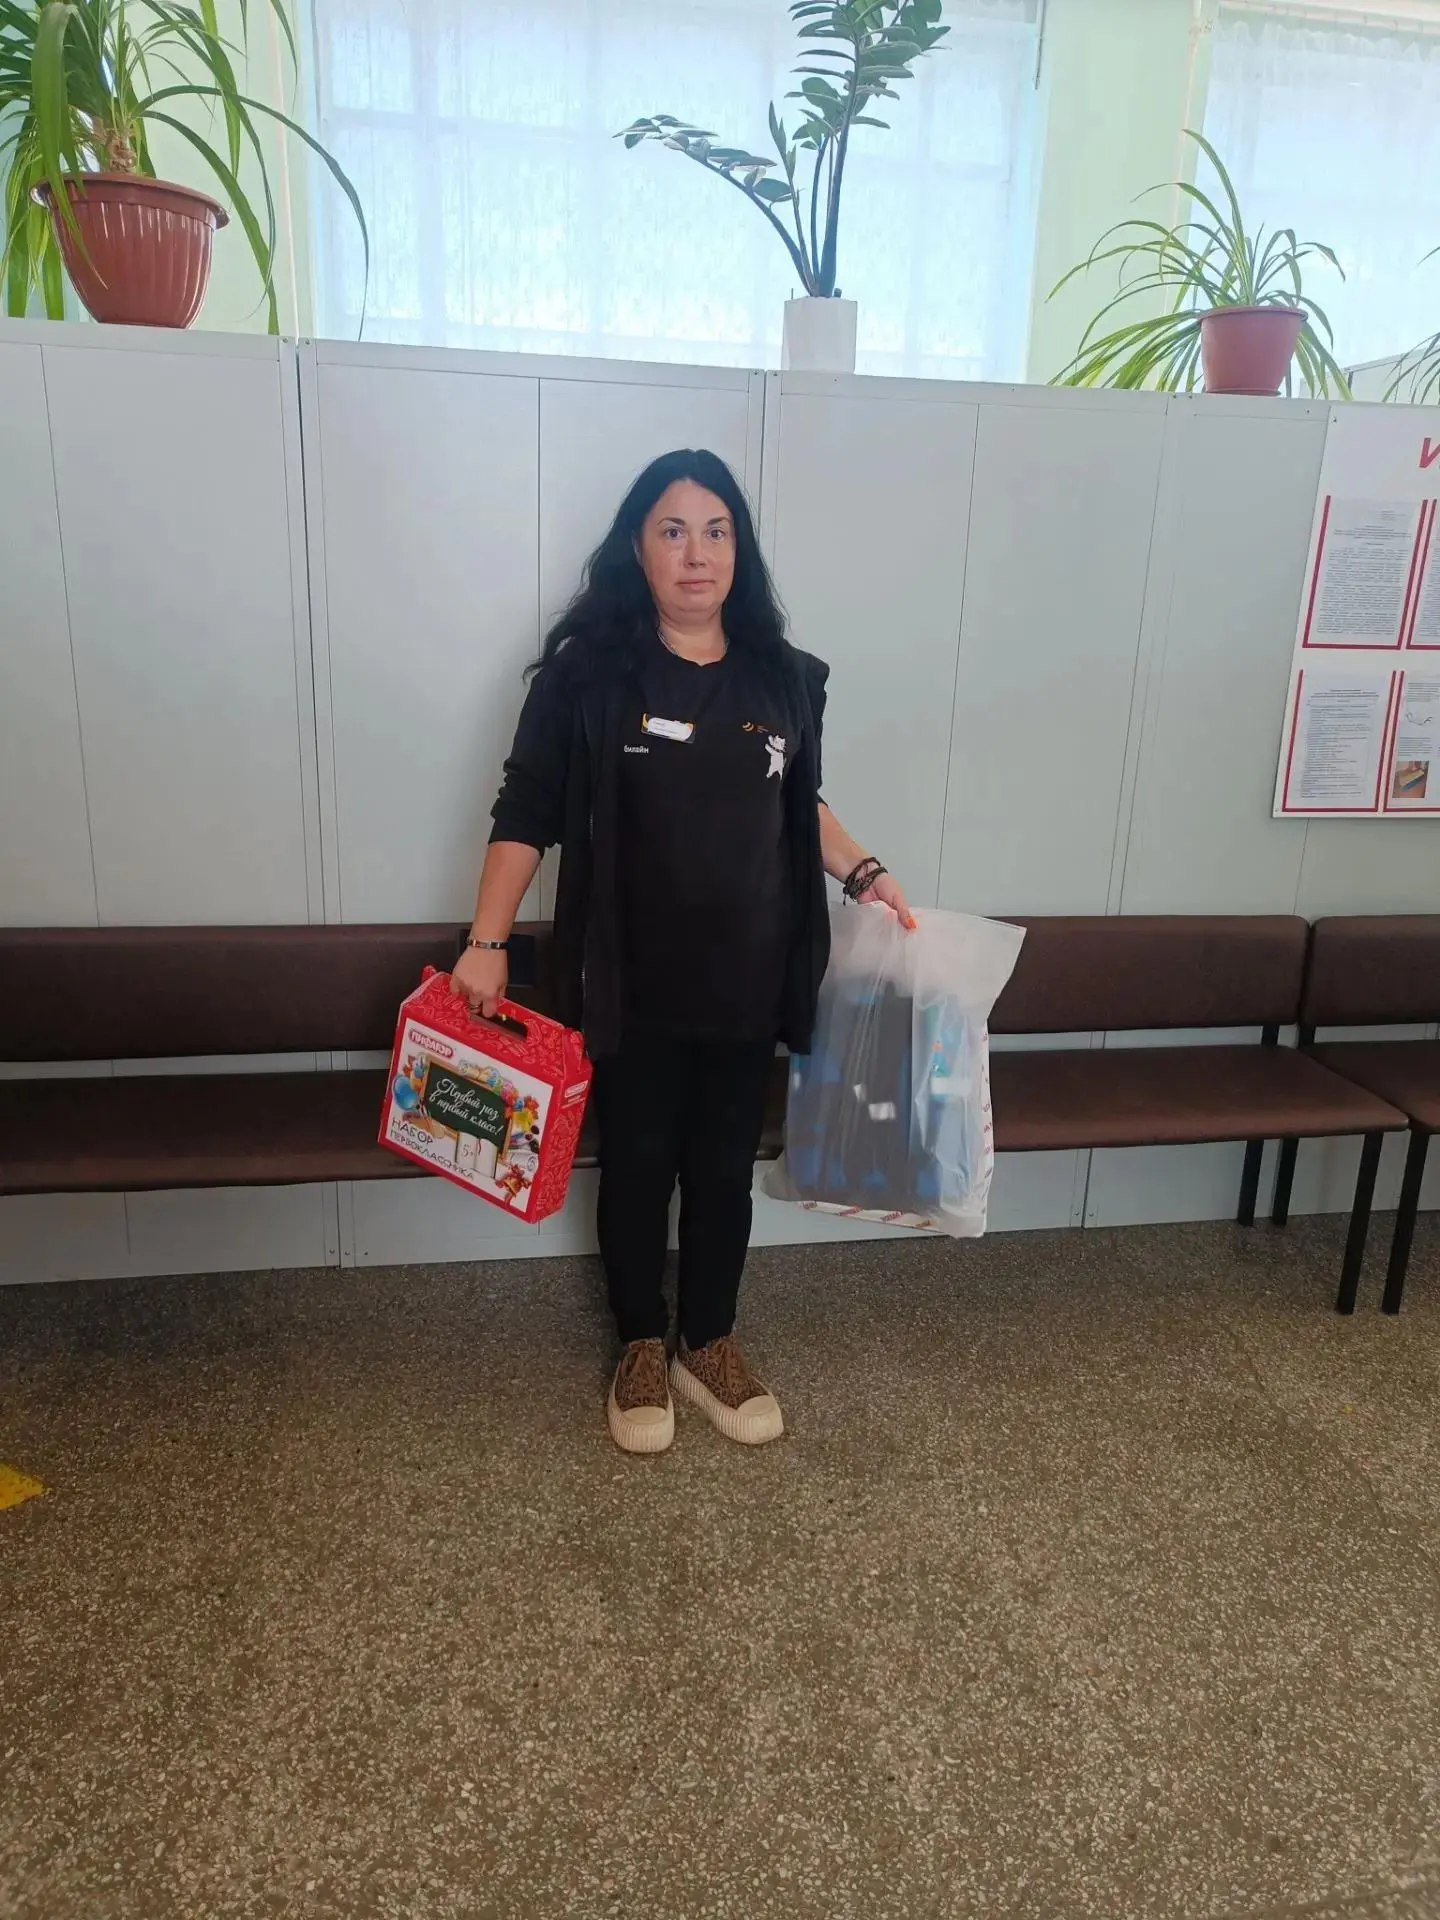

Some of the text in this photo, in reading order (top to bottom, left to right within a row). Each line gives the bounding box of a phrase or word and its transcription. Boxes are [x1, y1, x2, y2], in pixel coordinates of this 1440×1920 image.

[623, 744, 650, 754] билайн
[429, 1089, 441, 1103] в
[437, 1099, 469, 1120] первый
[436, 1078, 498, 1121] Первый раз
[392, 1118, 433, 1145] НАБОР
